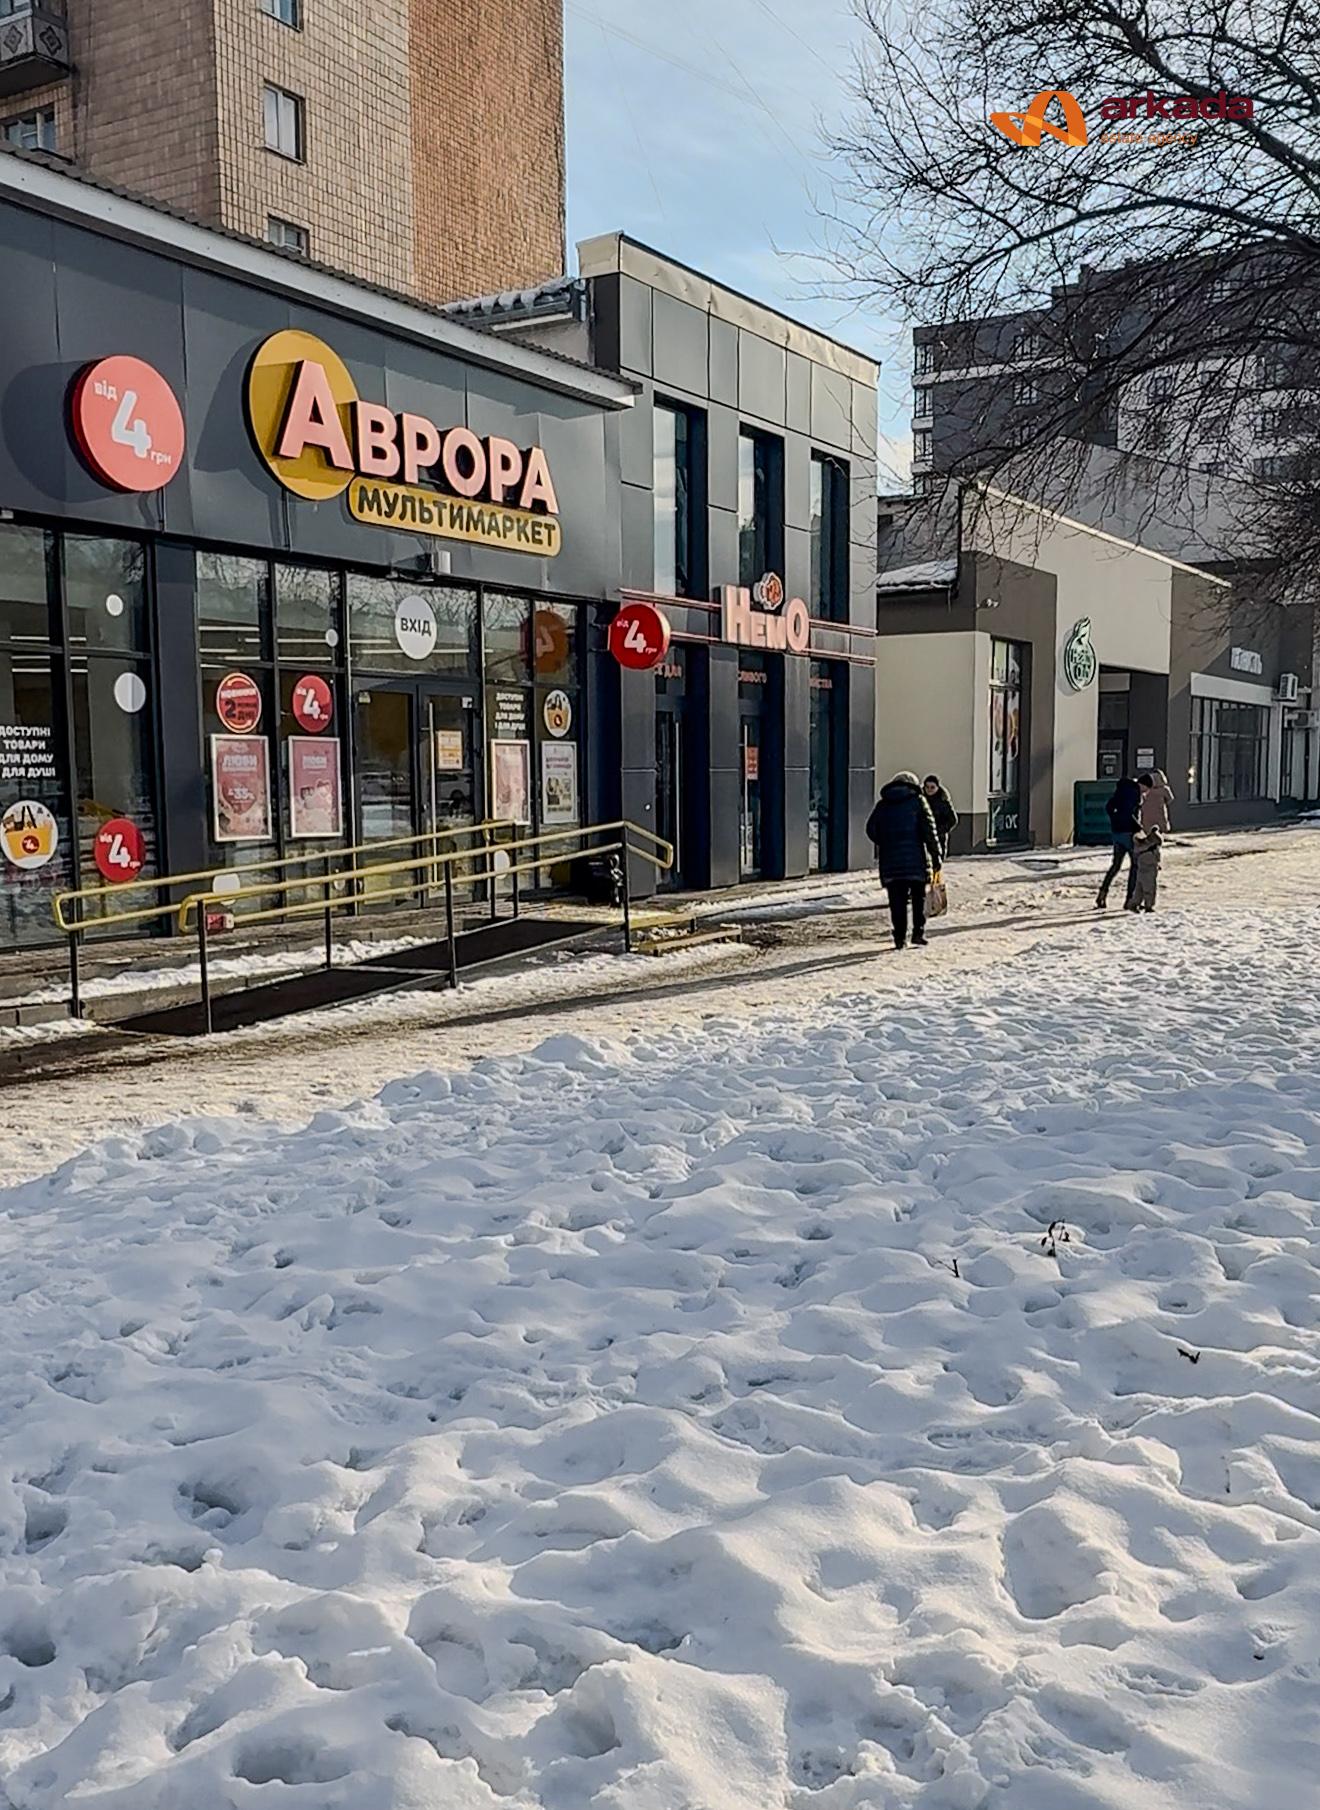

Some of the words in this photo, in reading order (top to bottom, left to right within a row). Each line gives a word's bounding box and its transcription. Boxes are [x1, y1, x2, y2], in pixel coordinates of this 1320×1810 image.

[94, 380, 118, 401] від
[111, 390, 152, 459] 4
[150, 450, 172, 465] грн
[278, 359, 560, 515] АВРОРА
[357, 486, 557, 548] МУЛЬТИМАРКЕТ
[401, 617, 432, 638] ВХІД
[624, 619, 647, 654] 4
[225, 699, 236, 718] 2
[303, 688, 321, 720] 4
[0, 725, 51, 737] ДОСТУПНІ
[3, 740, 46, 750] ТОВАРИ
[22, 753, 54, 765] ДОМУ
[2, 767, 26, 779] ДЛЯ
[27, 767, 56, 779] ДУШІ
[108, 834, 131, 868] 4
